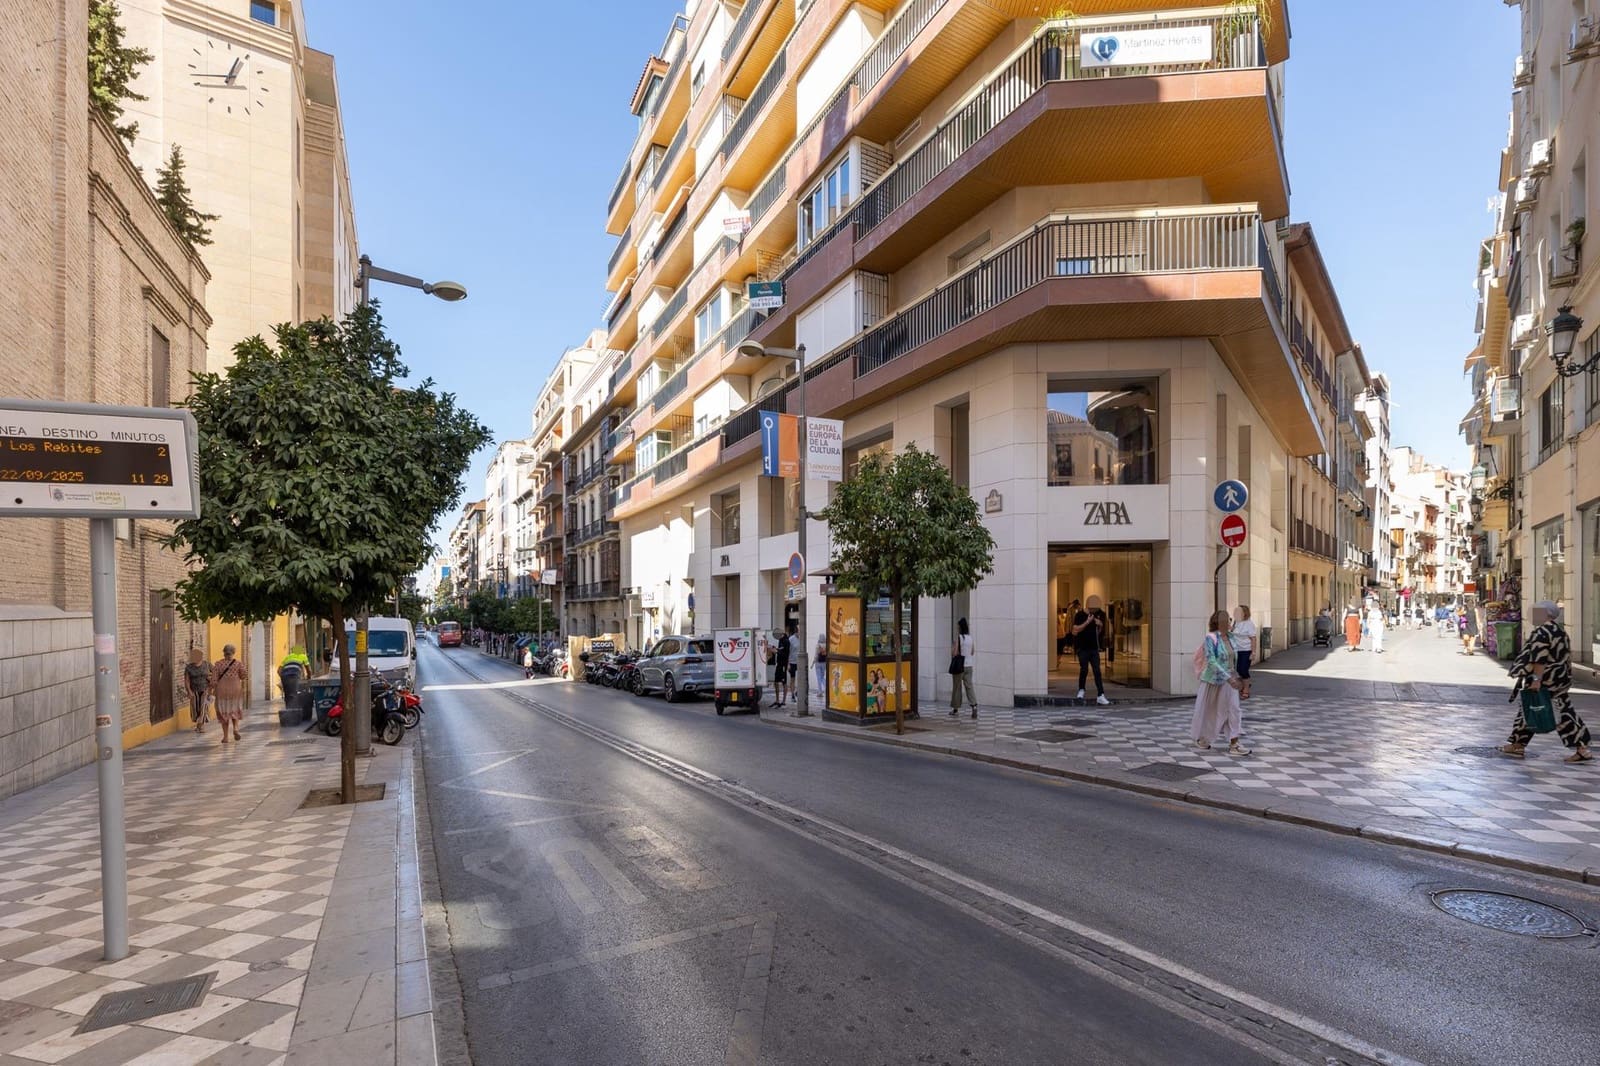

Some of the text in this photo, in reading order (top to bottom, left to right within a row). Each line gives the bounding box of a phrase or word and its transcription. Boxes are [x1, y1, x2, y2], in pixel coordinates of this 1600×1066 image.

[809, 423, 837, 432] CAPITAL
[42, 428, 98, 439] DESTINO
[111, 431, 166, 442] MINUTOS
[809, 431, 841, 440] EUROPEA
[10, 440, 166, 457] Los Rebites 2
[810, 446, 841, 455] CULTURA
[1, 469, 85, 482] 22/09/2025
[1083, 501, 1133, 526] ZARA
